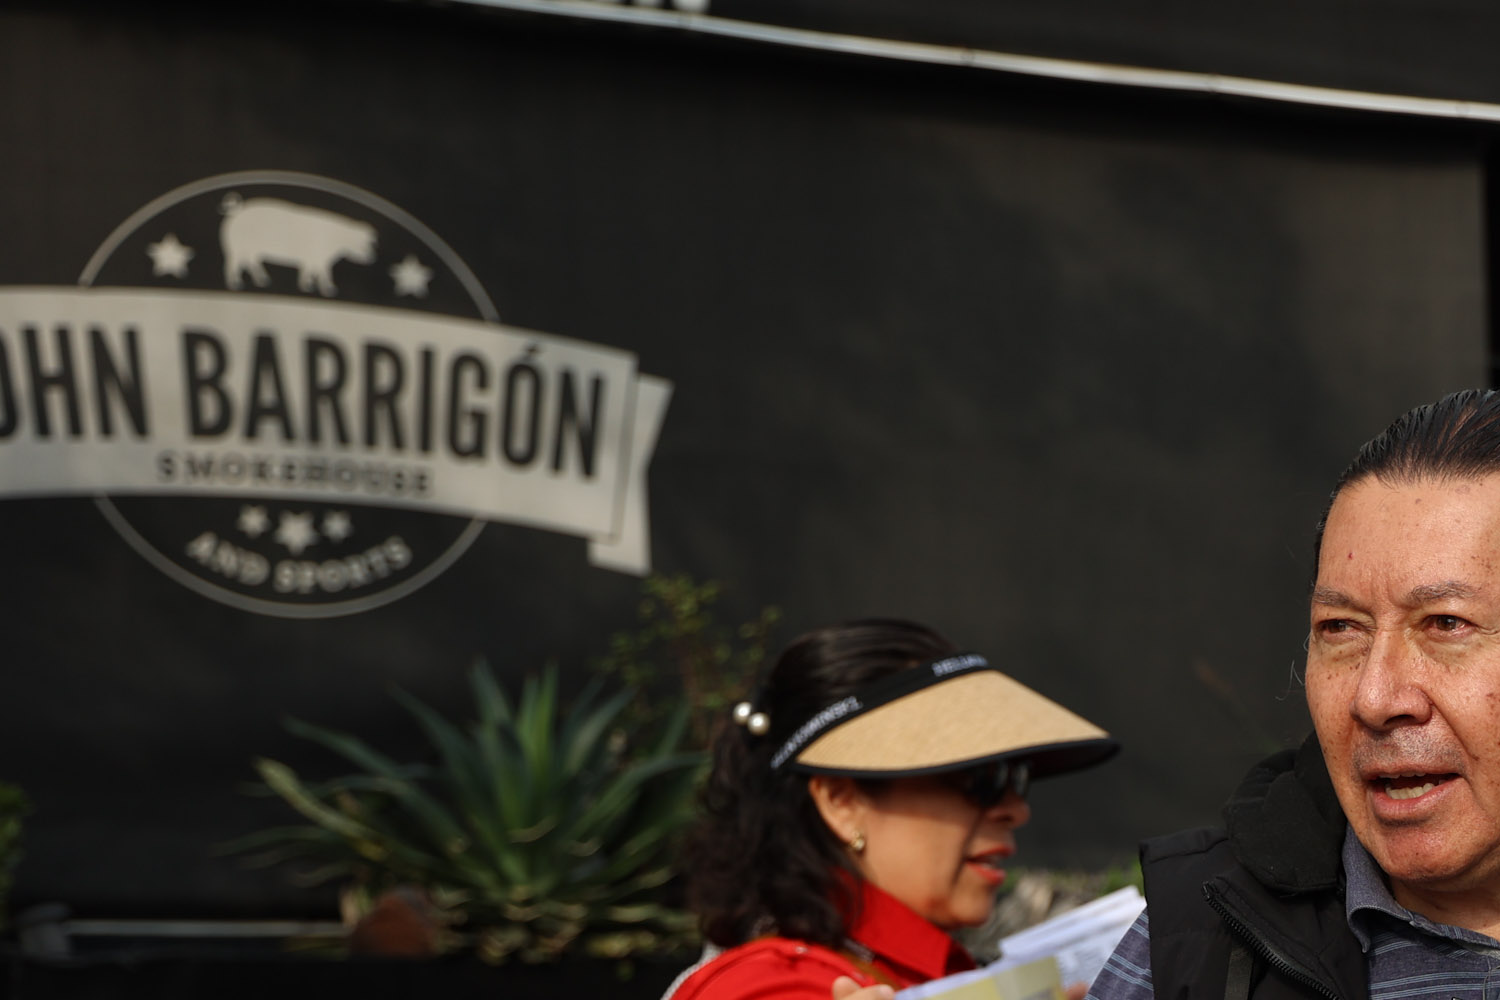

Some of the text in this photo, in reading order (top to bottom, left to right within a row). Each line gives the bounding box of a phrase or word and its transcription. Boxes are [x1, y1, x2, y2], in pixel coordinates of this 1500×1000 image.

[182, 327, 605, 478] BARRIGÓN
[156, 450, 434, 495] SMOKEHOUSE
[187, 532, 413, 595] AND SPORTS
